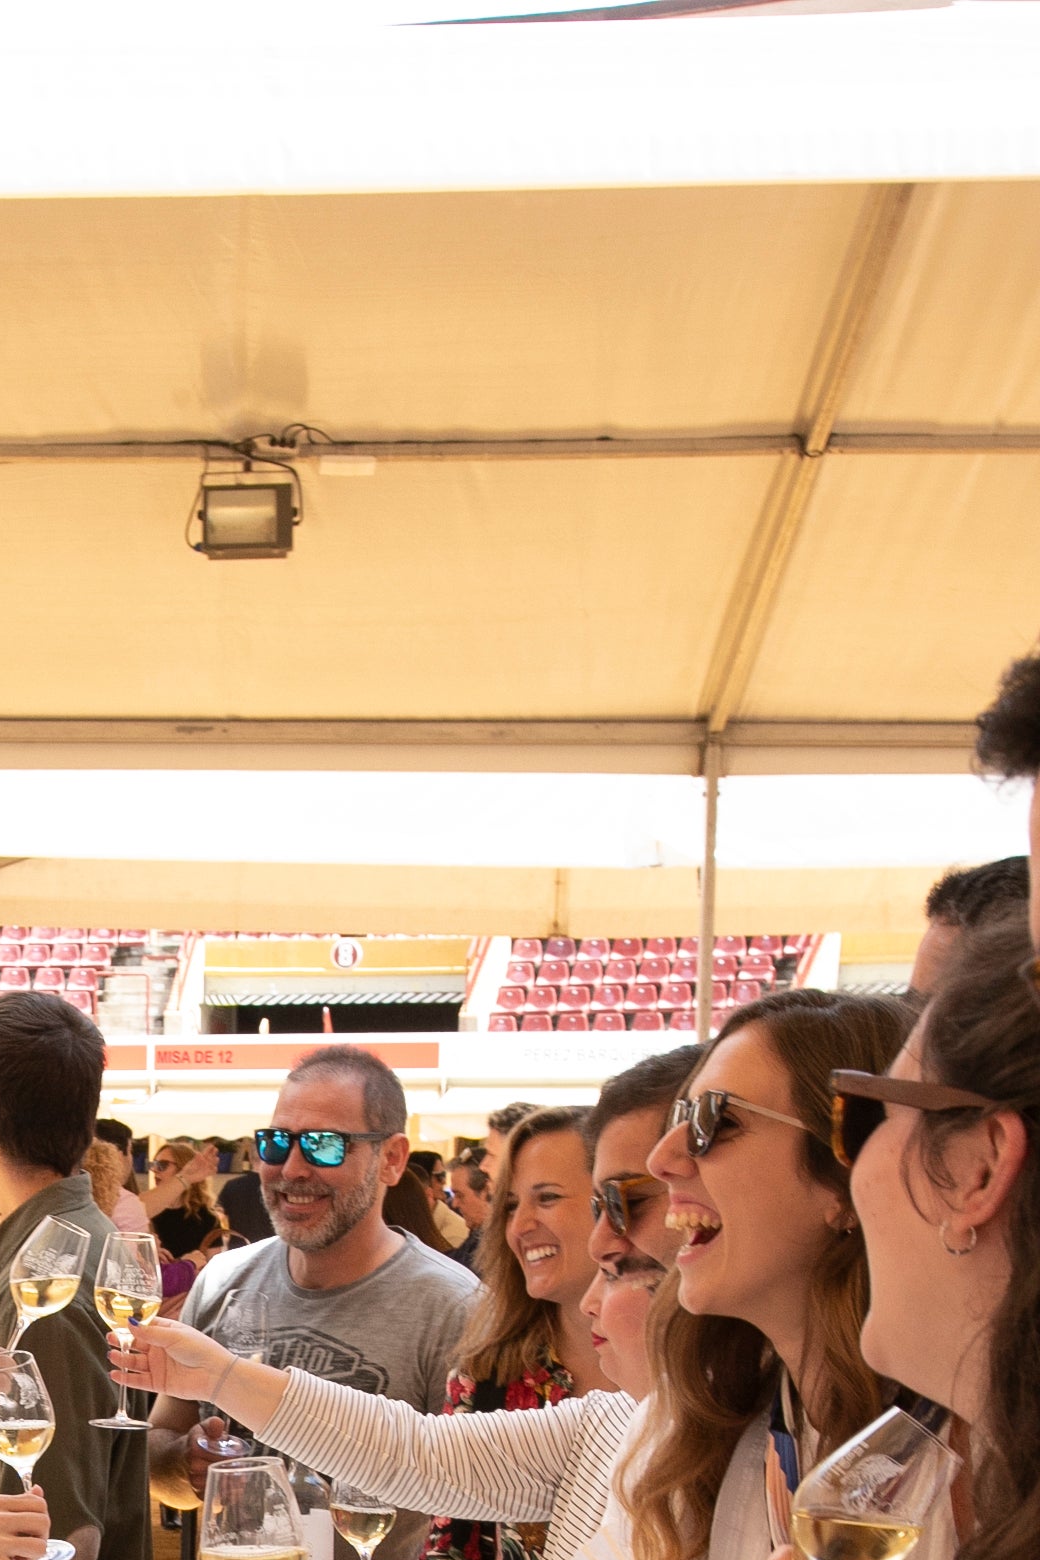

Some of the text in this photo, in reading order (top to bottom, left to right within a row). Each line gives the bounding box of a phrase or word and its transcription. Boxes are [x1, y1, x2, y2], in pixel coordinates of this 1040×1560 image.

[156, 1050, 233, 1064] MISA DE 12
[576, 1047, 663, 1062] BARQUER
[266, 1338, 335, 1374] ETROL
